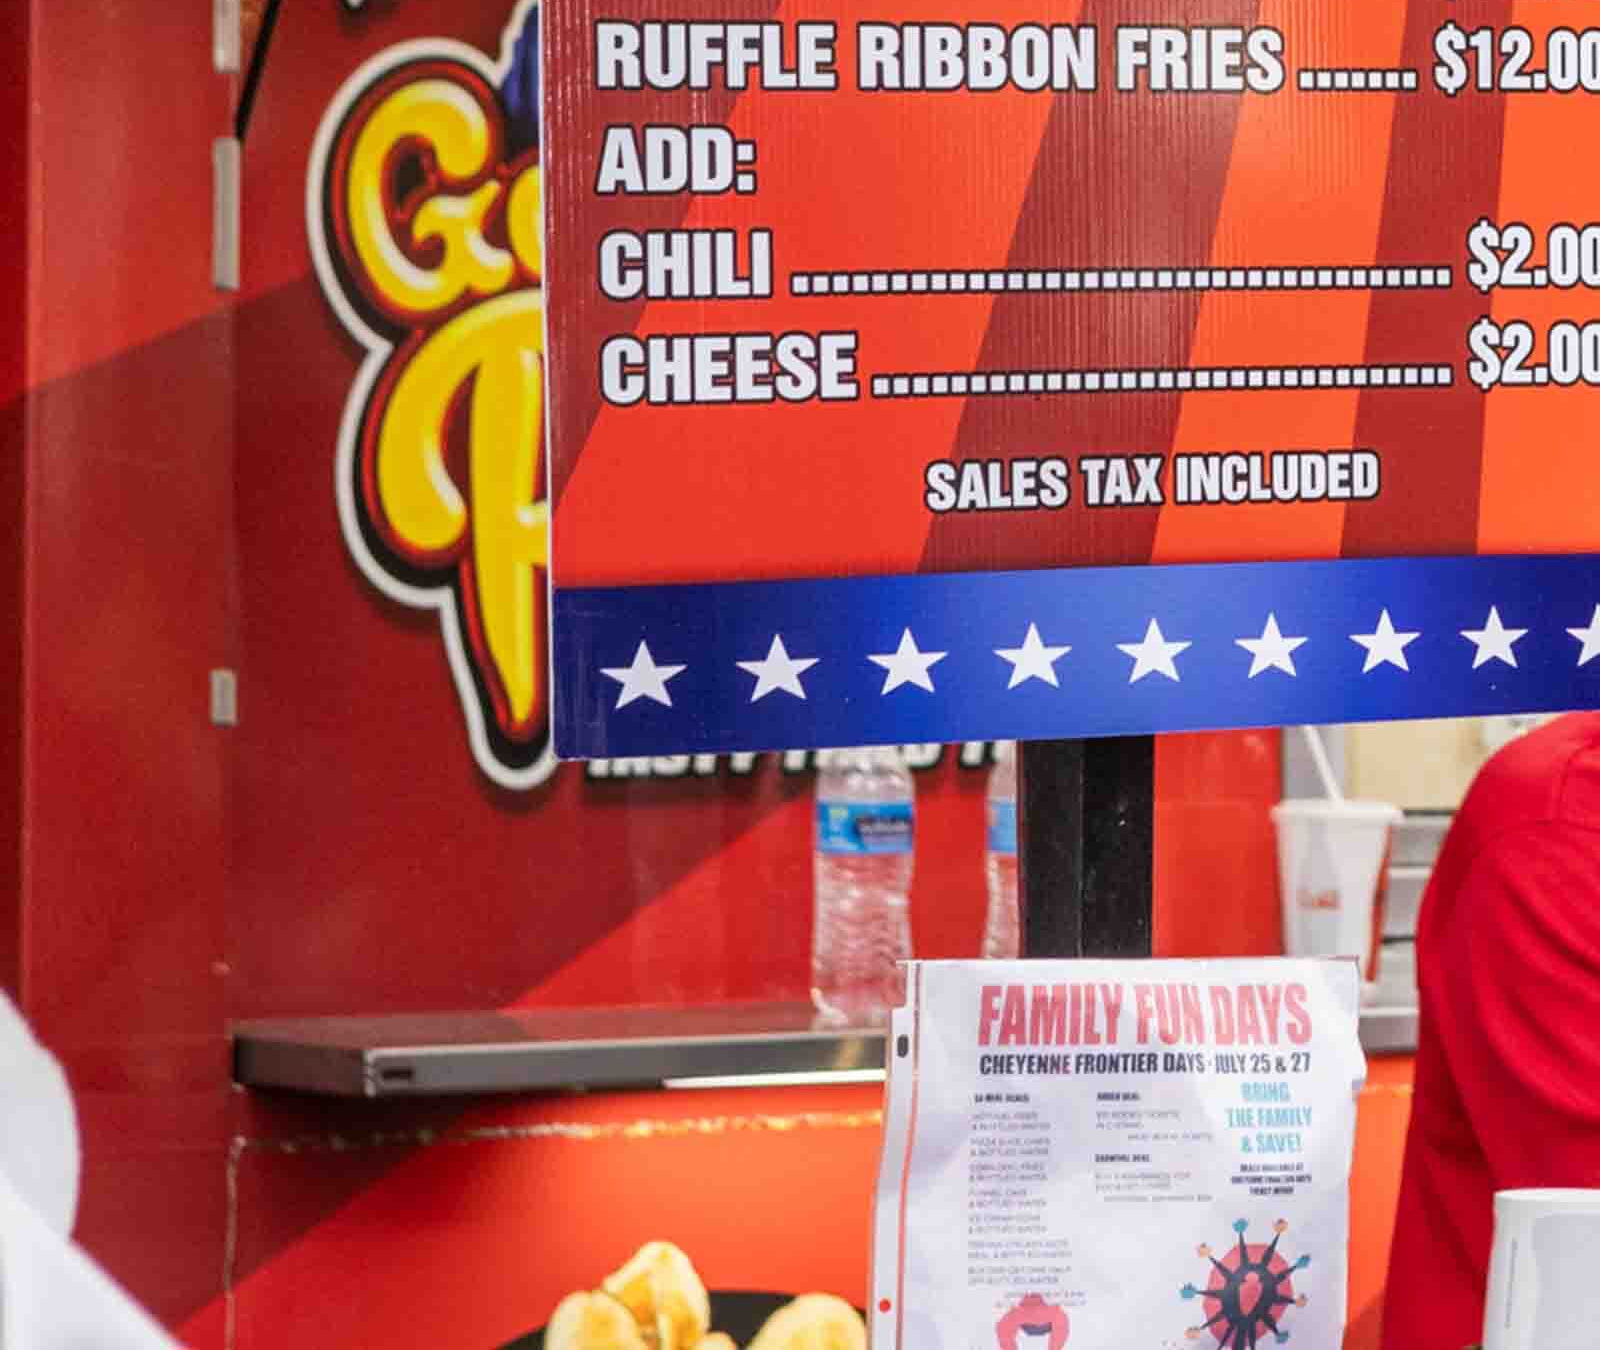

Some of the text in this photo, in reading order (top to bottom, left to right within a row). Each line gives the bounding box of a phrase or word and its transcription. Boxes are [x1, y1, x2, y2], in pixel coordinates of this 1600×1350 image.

[594, 20, 838, 91] RUFFLE
[856, 22, 1098, 92] RIBBON
[1114, 24, 1287, 94] FRIES
[594, 124, 758, 195] ADD:
[598, 229, 773, 301] CHILI
[599, 331, 860, 406] CHEESE
[924, 450, 1381, 513] SALES TAX INCLUDED
[977, 982, 1312, 1047] FAMILY FUN DAYS
[979, 1054, 1071, 1075] CHEYENNE
[1075, 1053, 1158, 1074] FRONTIER
[1163, 1053, 1206, 1073] DAYS
[1215, 1053, 1247, 1074] JULY
[1250, 1053, 1272, 1073] 25
[1290, 1052, 1312, 1073] 27
[1257, 1106, 1312, 1128] FAMILY
